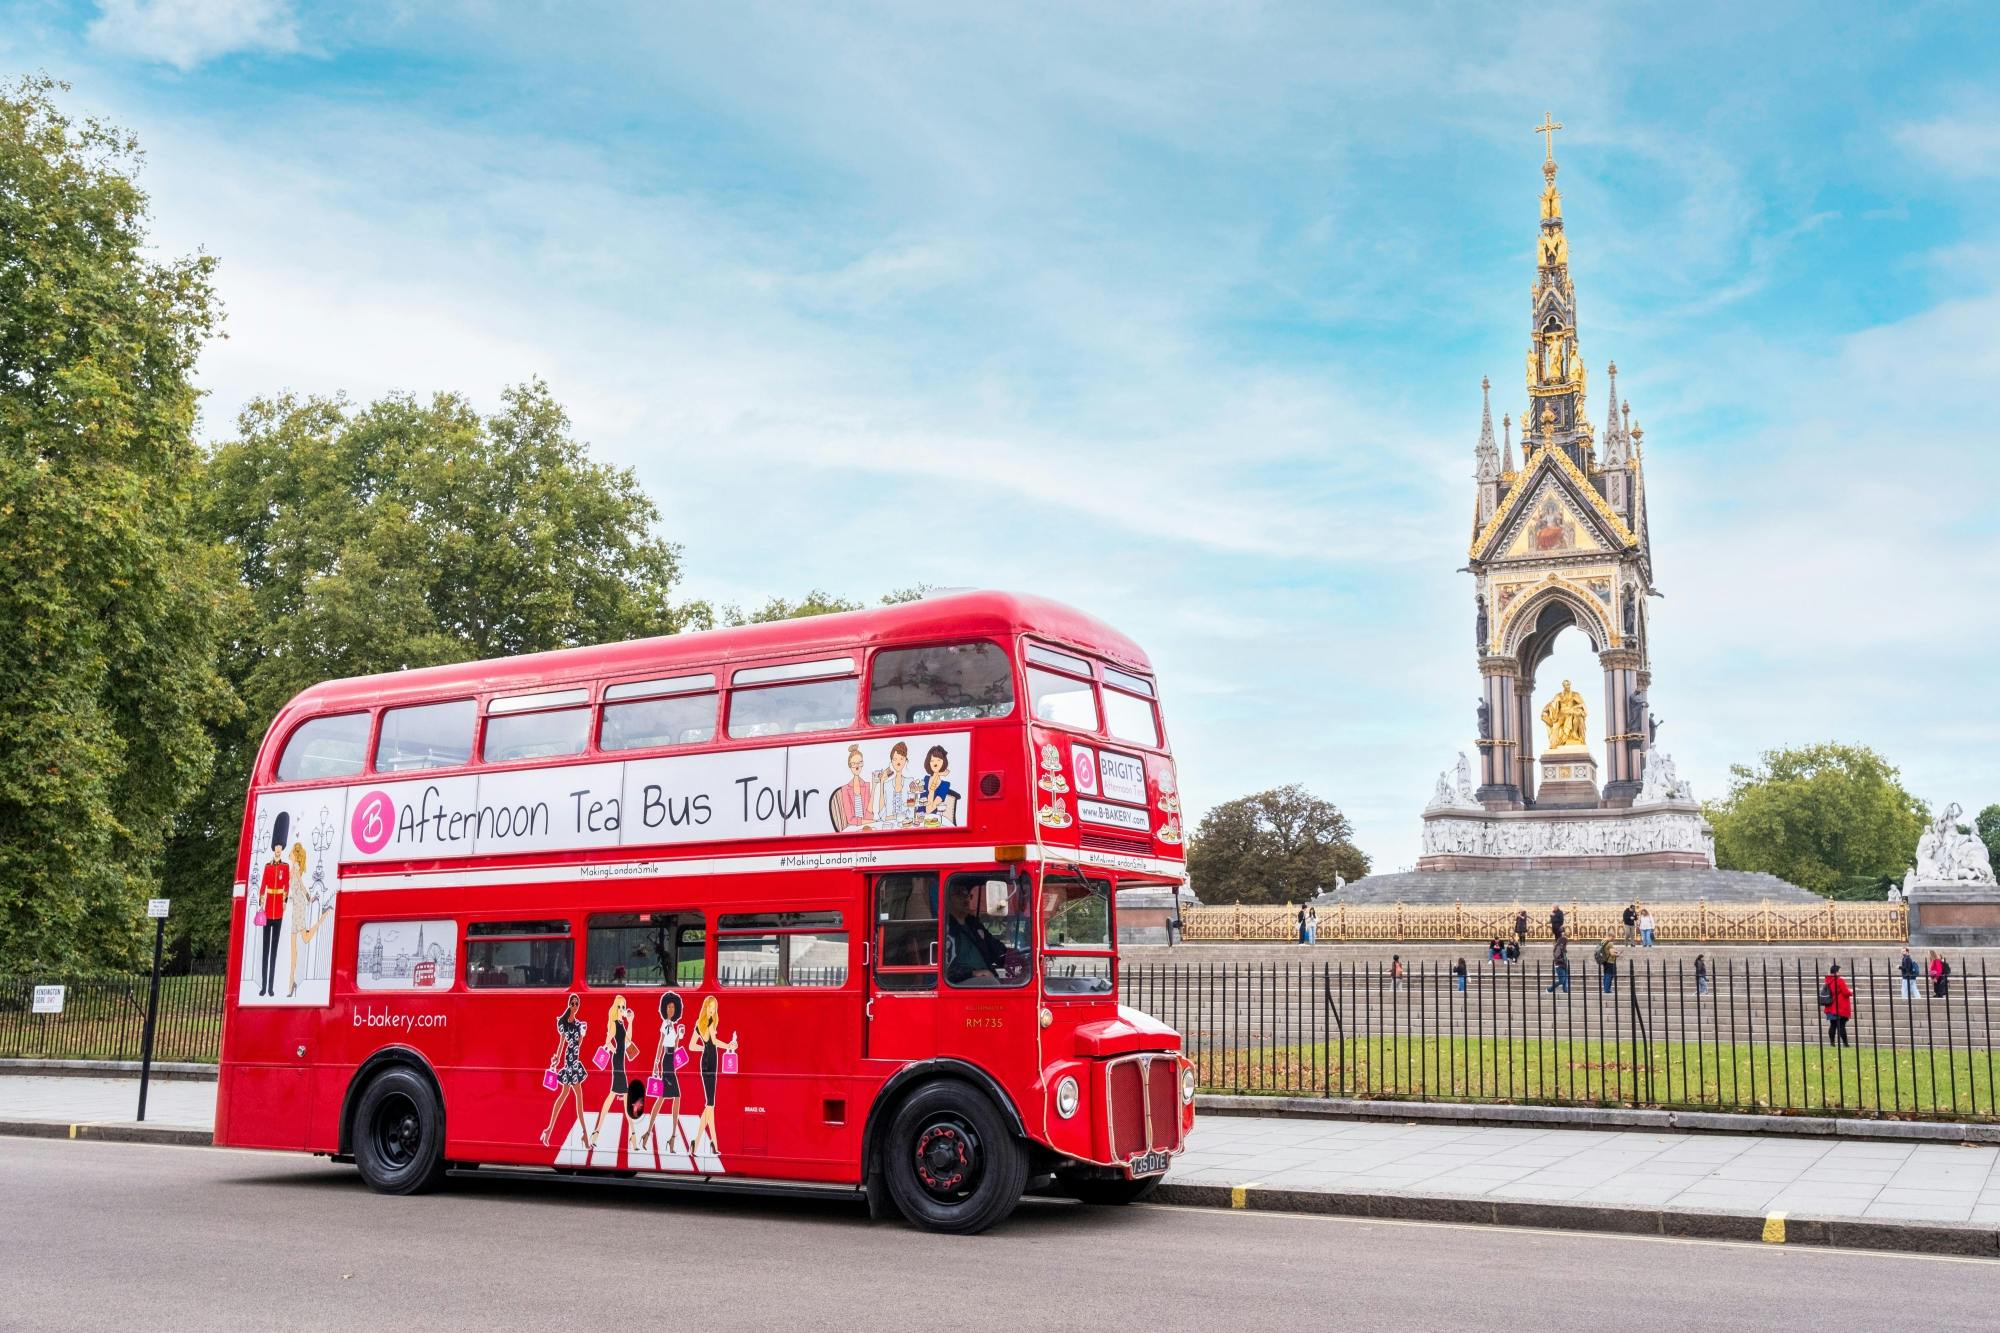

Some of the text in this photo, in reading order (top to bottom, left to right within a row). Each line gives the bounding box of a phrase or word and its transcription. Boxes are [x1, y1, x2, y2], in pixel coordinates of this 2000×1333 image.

[1101, 758, 1142, 782] BRIGIT'S
[397, 776, 820, 843] Afternoon Tea Bus Tour
[580, 863, 659, 878] MakingLondonSmile
[353, 1005, 447, 1034] b-bakery.com
[966, 1018, 1003, 1028] RM 735
[1149, 1153, 1166, 1169] DYE
